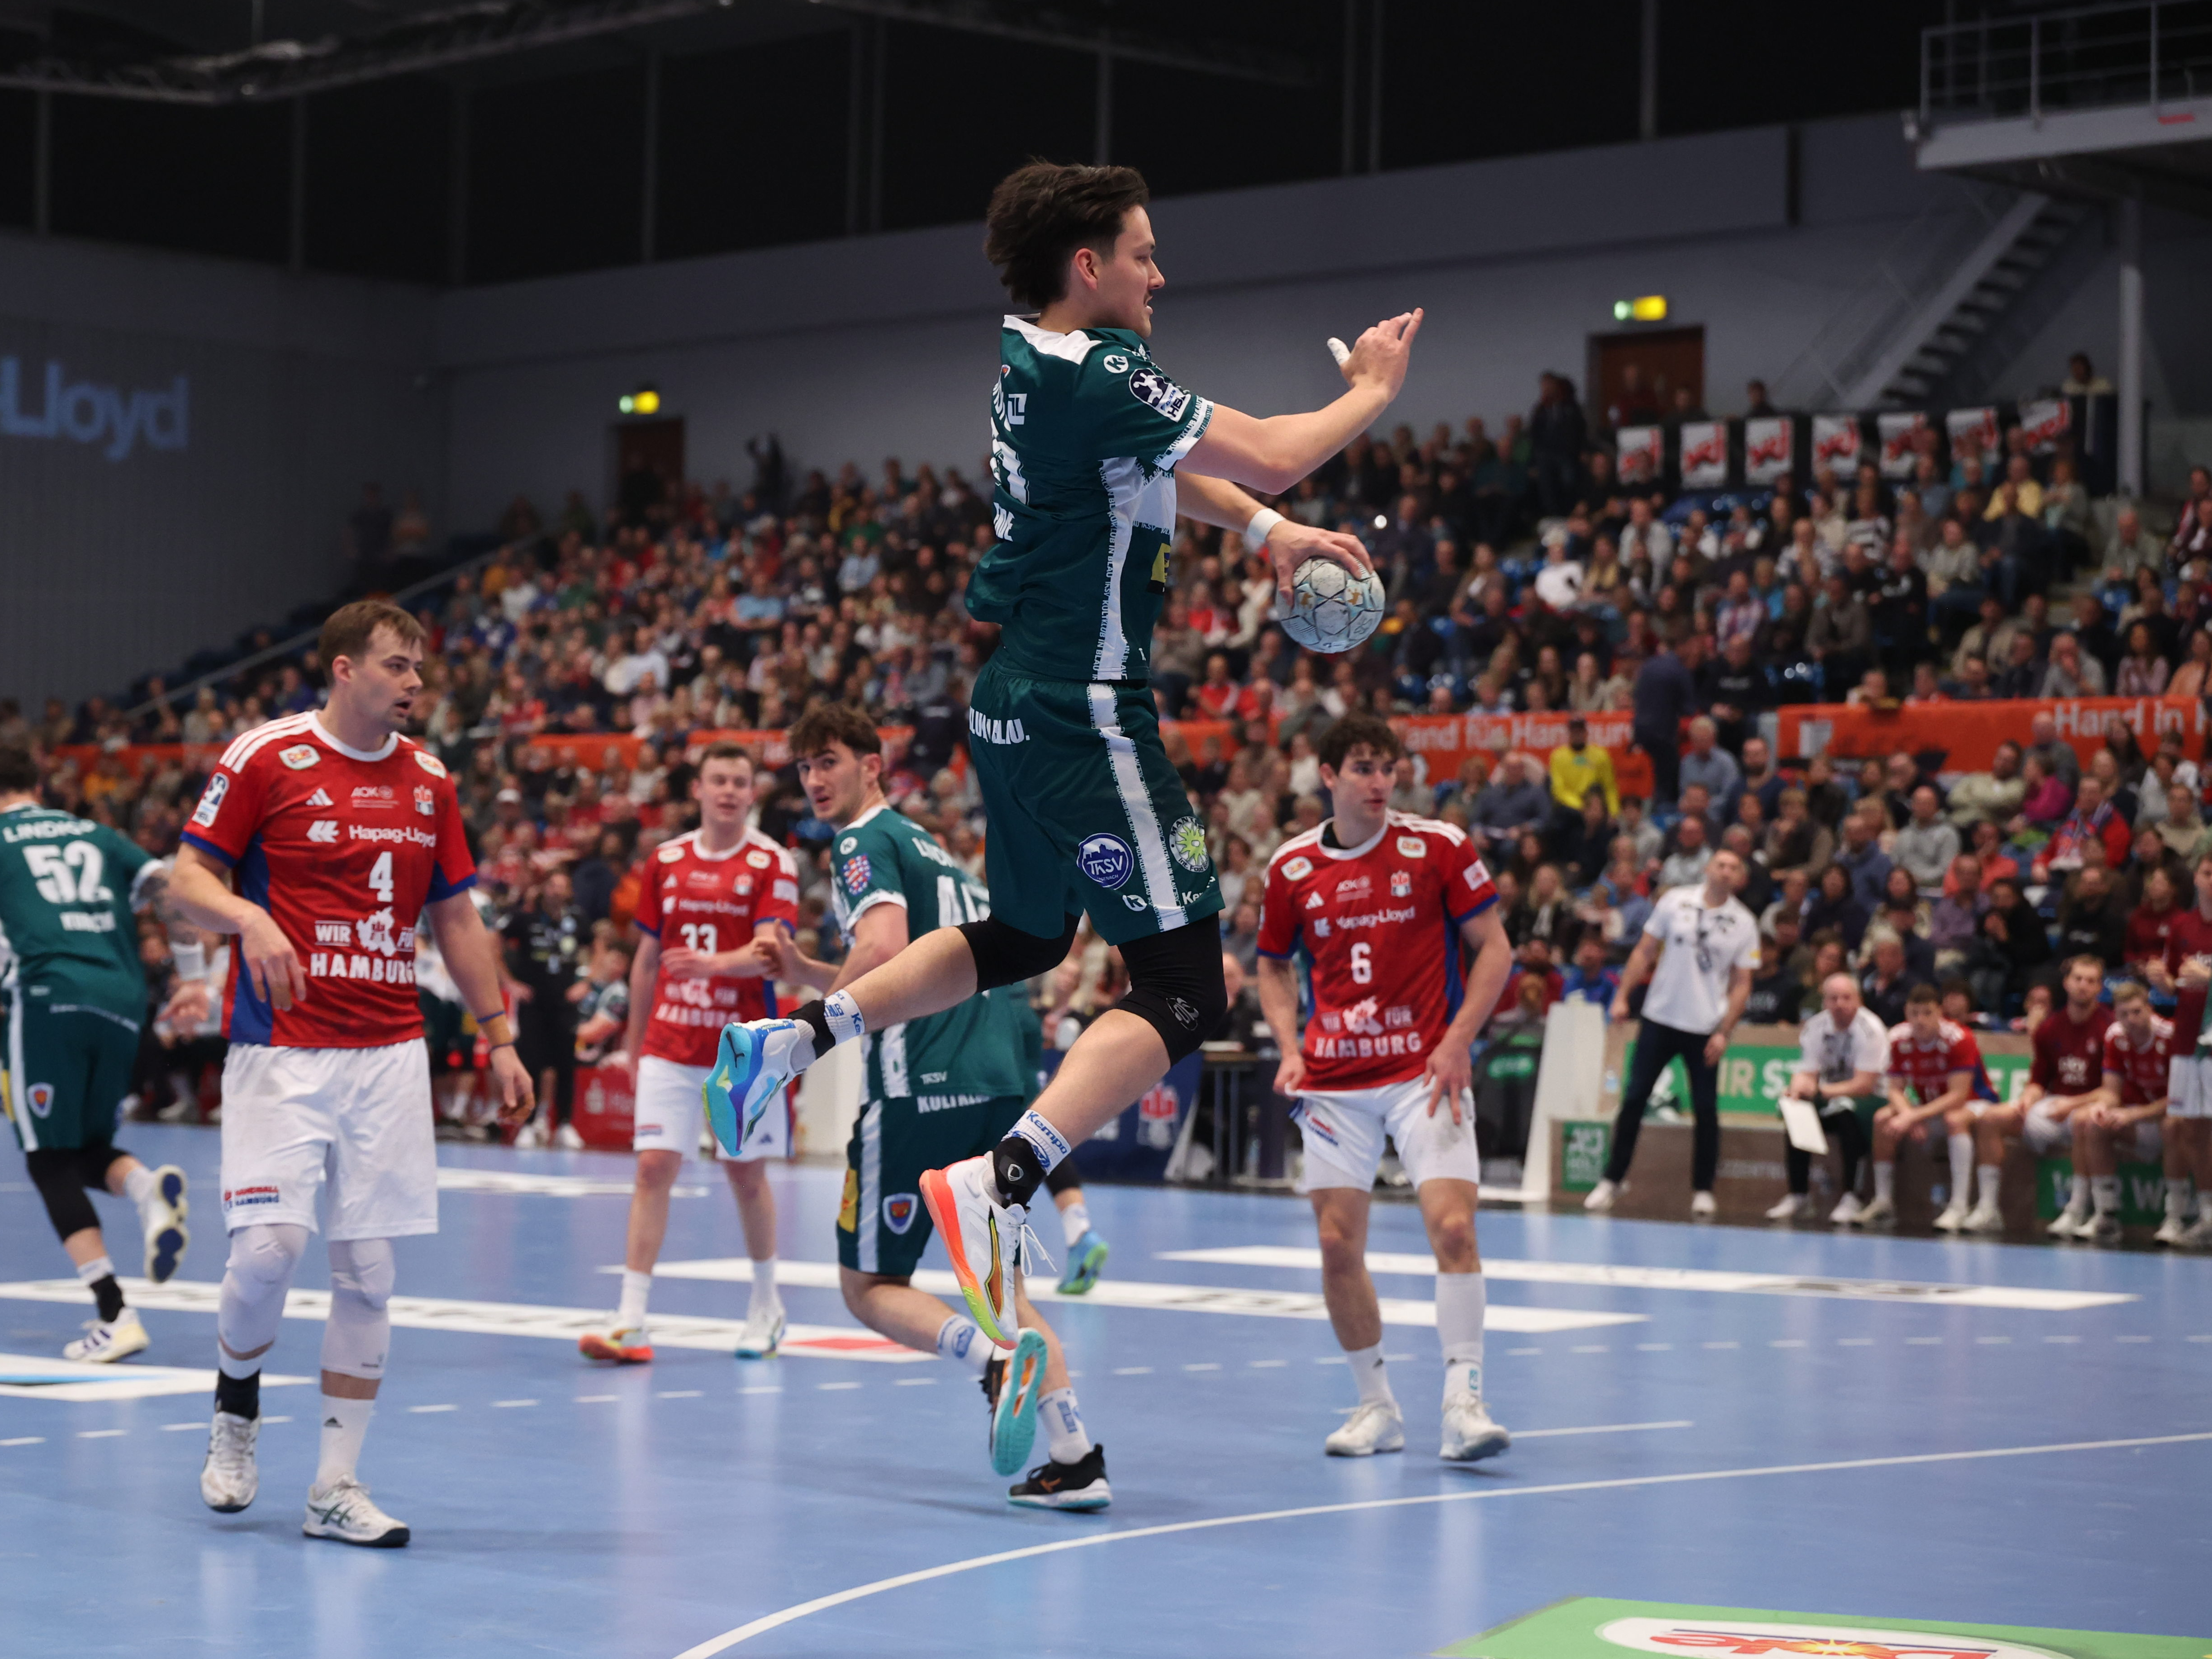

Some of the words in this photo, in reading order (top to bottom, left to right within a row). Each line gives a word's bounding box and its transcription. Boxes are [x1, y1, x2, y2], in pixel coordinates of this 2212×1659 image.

[1100, 600, 1109, 639] KULTKLUB
[1092, 649, 1103, 672] BLAU
[1116, 785, 1128, 810] KULTKLUB
[1127, 816, 1135, 831] BLAU
[1135, 846, 1146, 873] KULTKLUB
[1144, 881, 1152, 896] BLAU
[22, 840, 114, 904] 52
[368, 851, 394, 902] 4
[315, 924, 351, 943] WIR
[1350, 942, 1372, 984] 6
